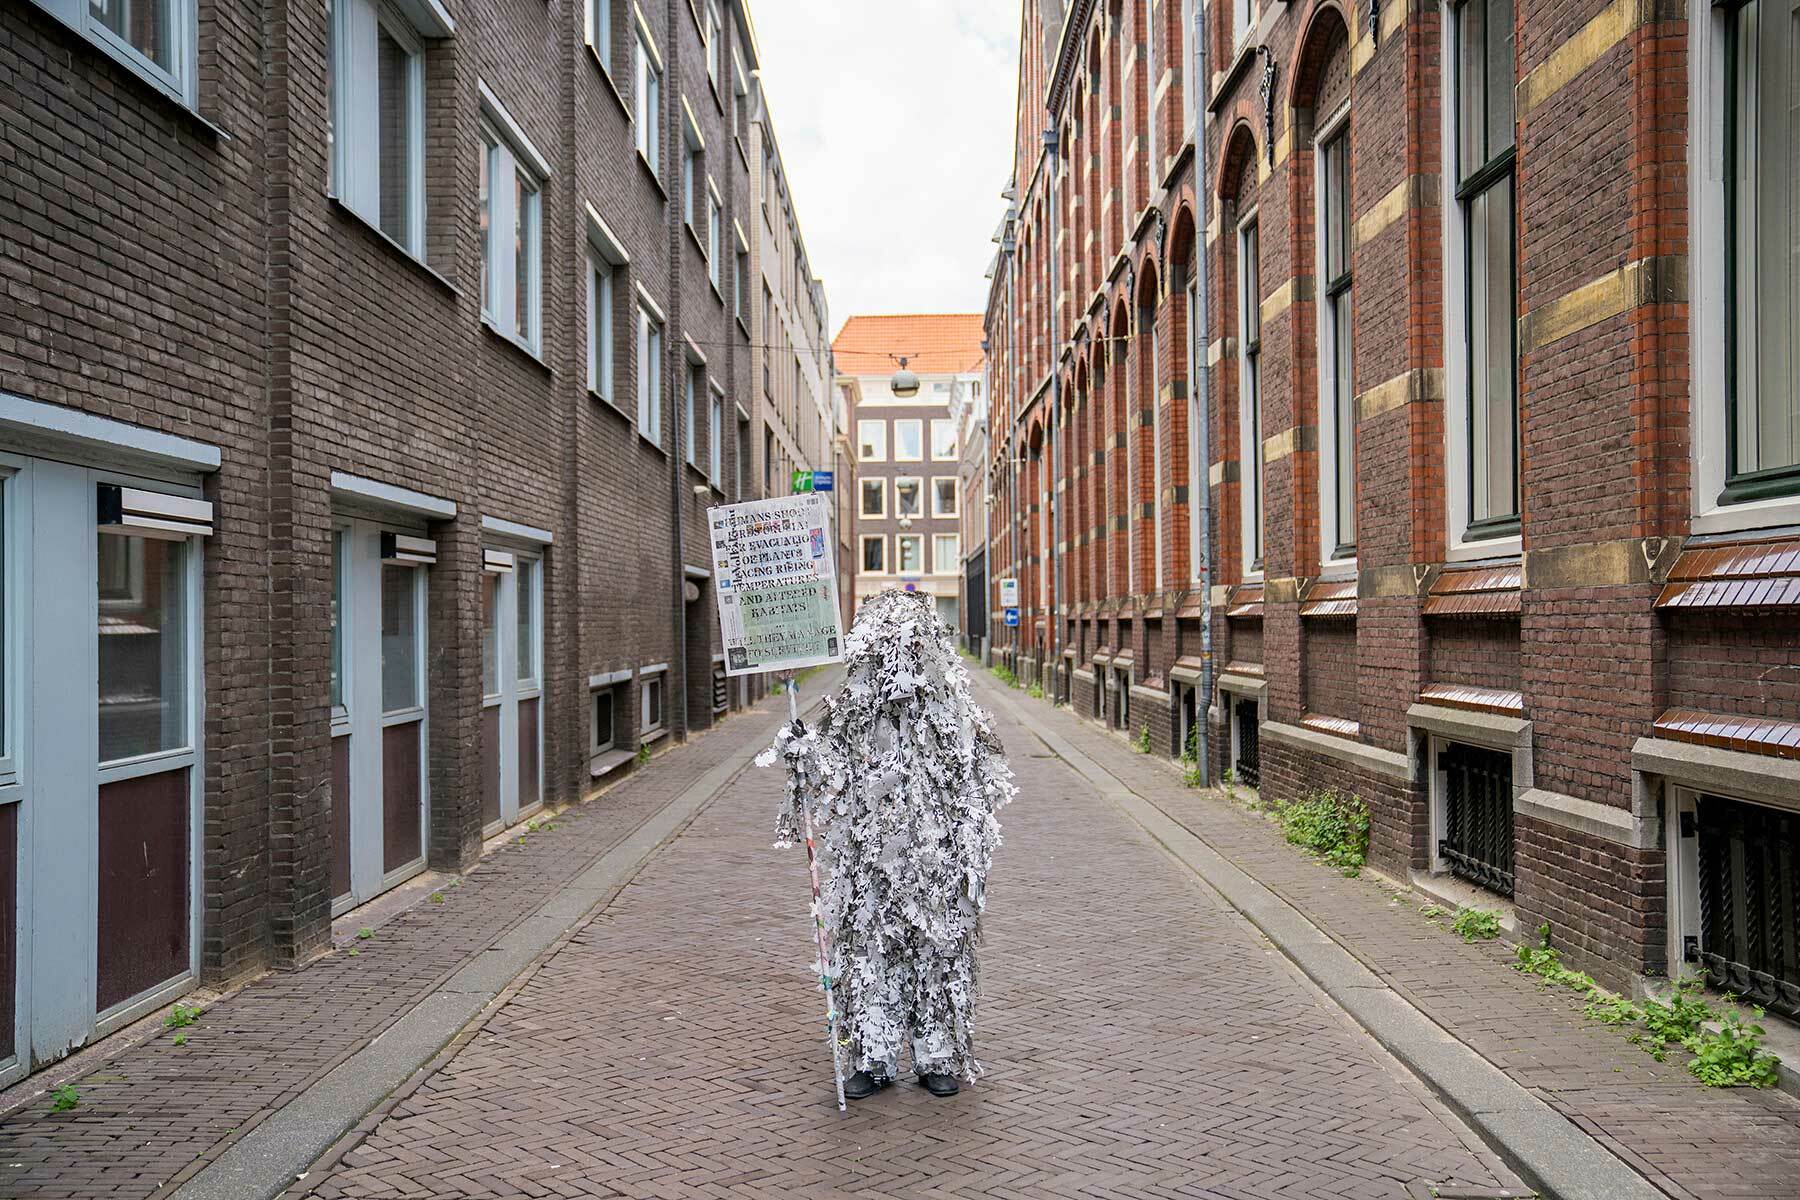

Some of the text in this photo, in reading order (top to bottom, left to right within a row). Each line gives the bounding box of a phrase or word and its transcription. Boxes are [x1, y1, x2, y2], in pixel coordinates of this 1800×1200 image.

[724, 512, 771, 526] HUMANS
[758, 547, 802, 562] PLANTS
[775, 560, 813, 574] RISING
[732, 572, 819, 593] TEMPERATURES
[738, 594, 763, 606] AND
[764, 586, 816, 602] ALTERED
[751, 601, 806, 618] HABITATS
[756, 631, 786, 643] THEY
[787, 624, 836, 640] MANAGE
